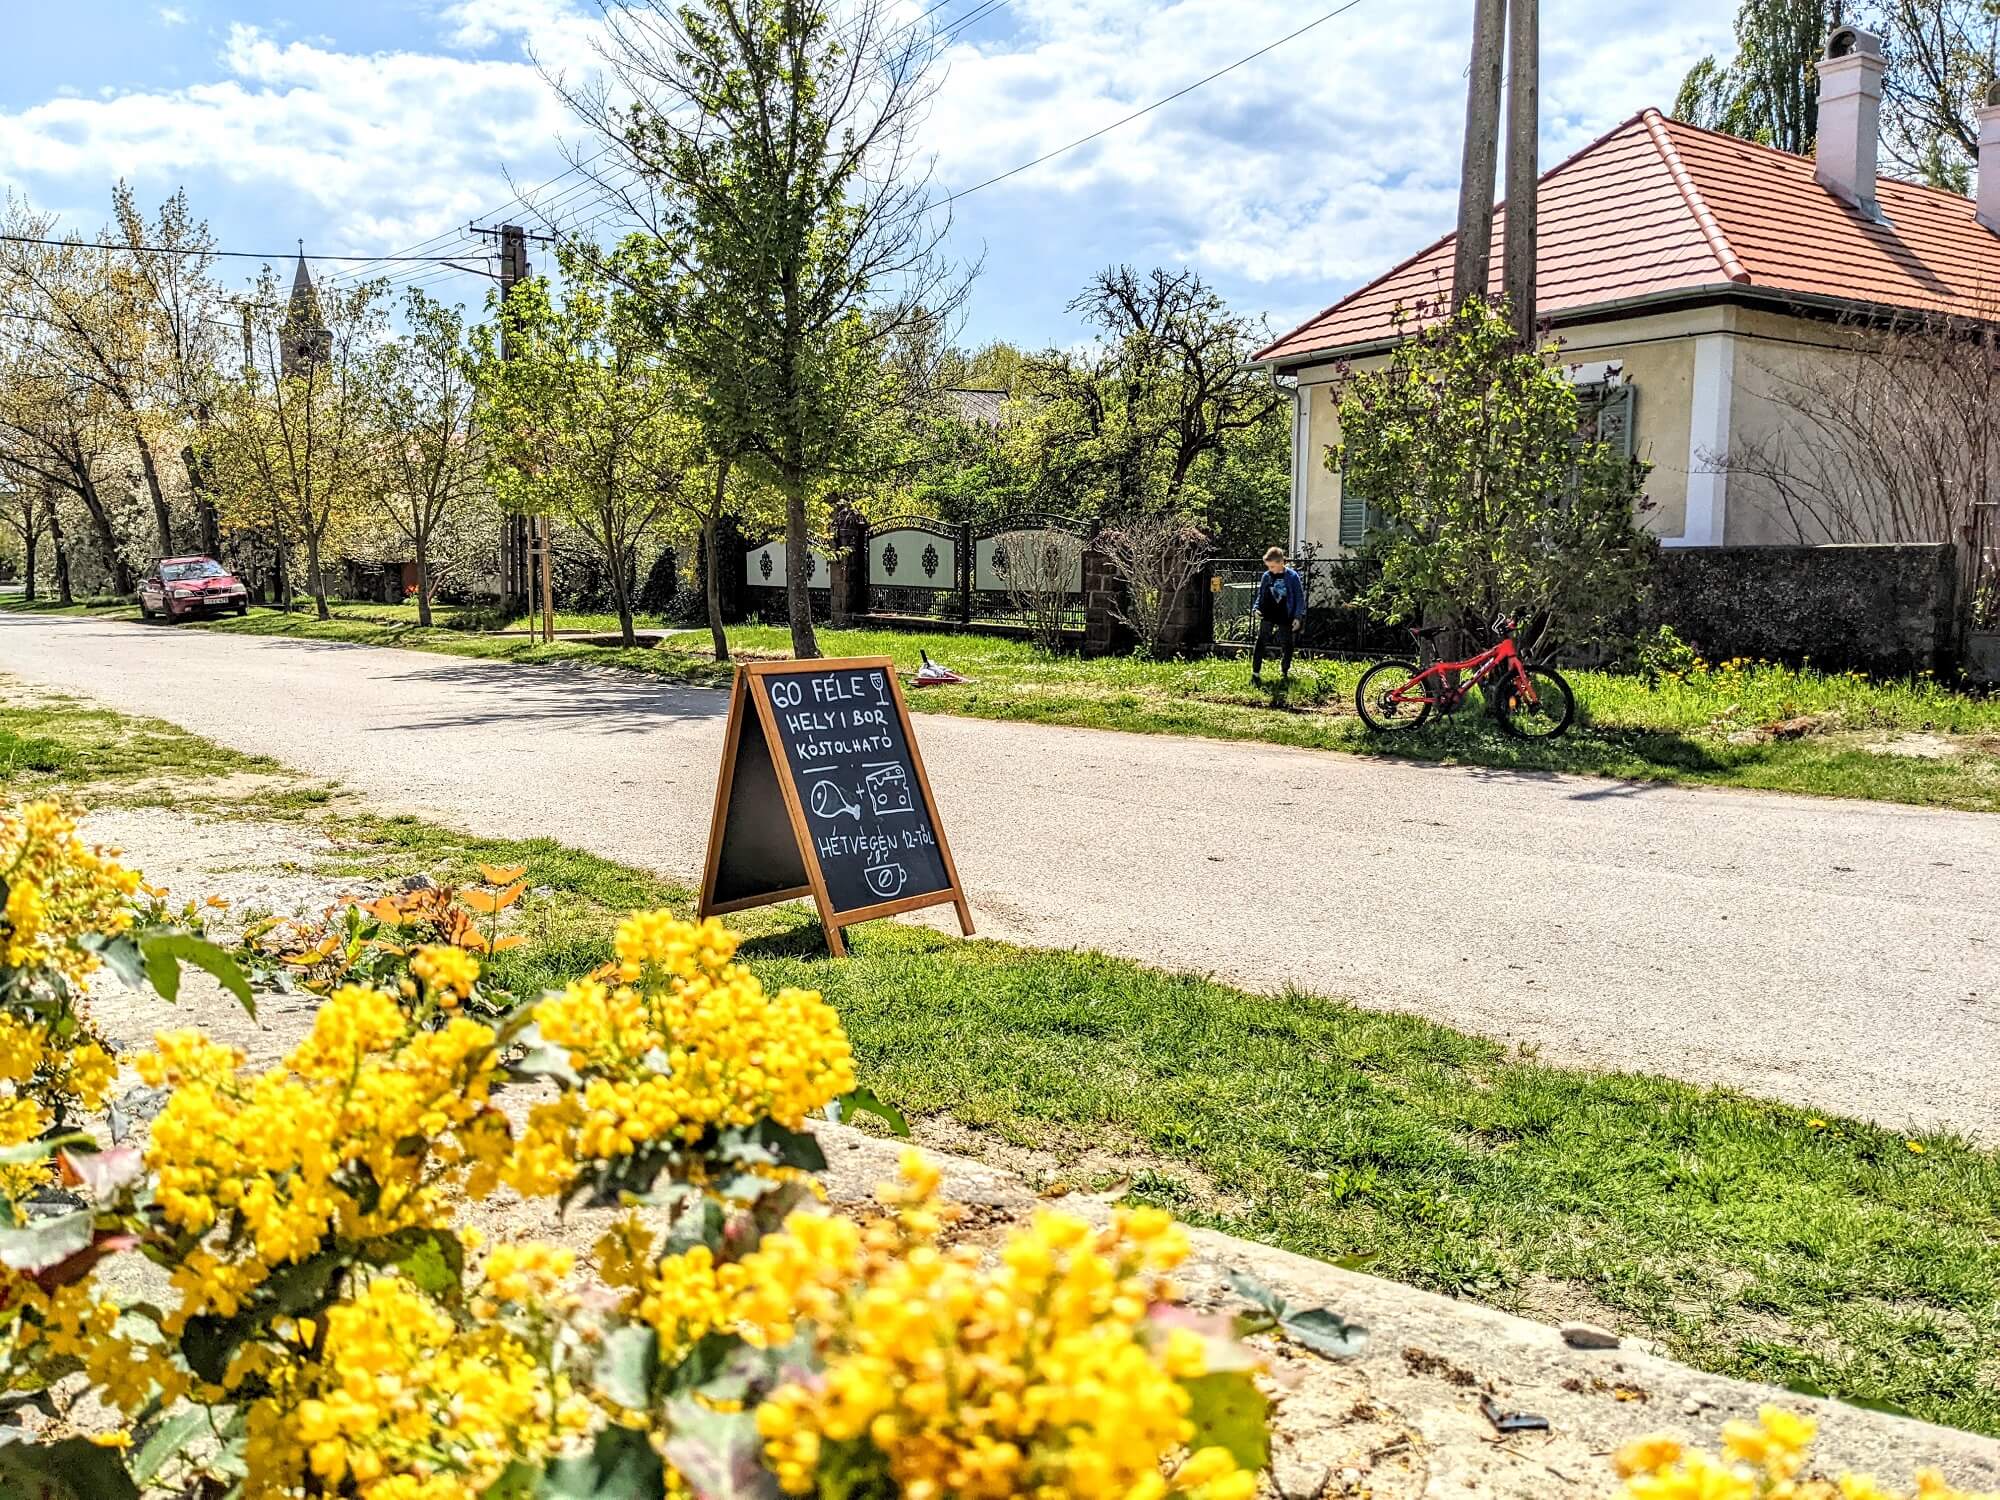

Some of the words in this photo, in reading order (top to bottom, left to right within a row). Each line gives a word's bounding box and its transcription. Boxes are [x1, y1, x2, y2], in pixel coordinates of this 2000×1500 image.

[811, 673, 865, 702] FÉLE
[852, 709, 888, 726] BOR
[796, 727, 892, 760] KÓSTOLHATÓ
